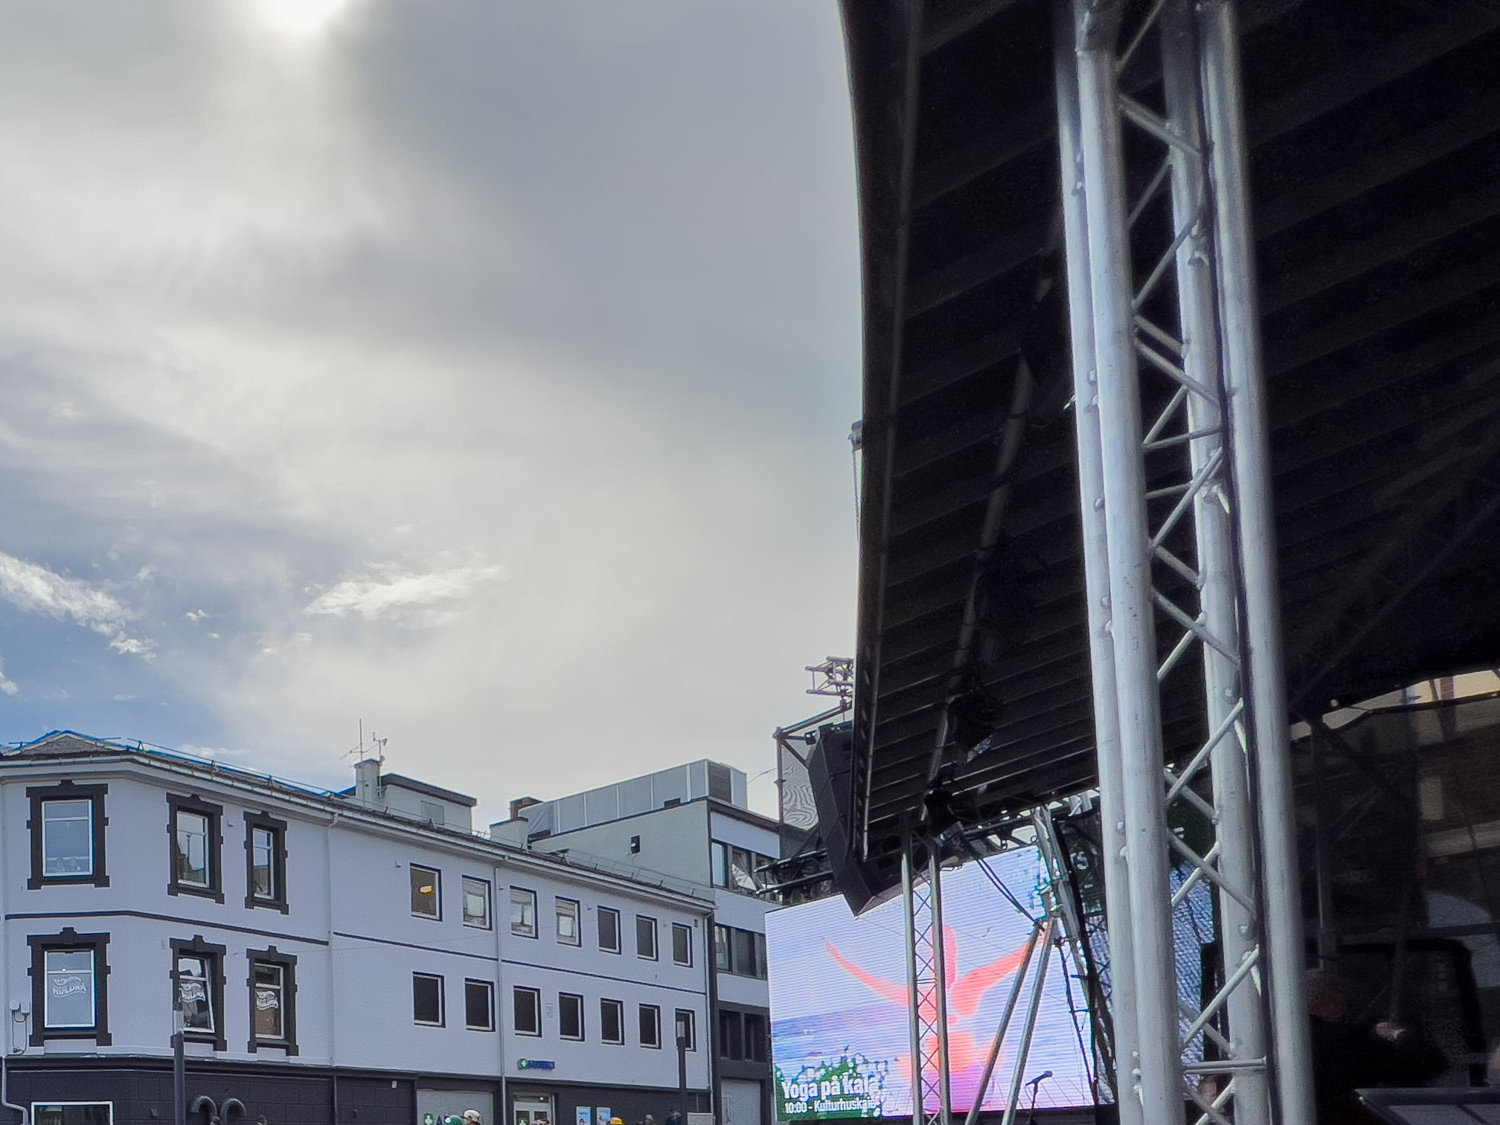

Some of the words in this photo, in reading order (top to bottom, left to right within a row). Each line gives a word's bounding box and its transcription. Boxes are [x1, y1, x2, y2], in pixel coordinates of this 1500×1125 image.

[781, 1080, 818, 1102] Yoga
[820, 1075, 841, 1100] på
[784, 1101, 808, 1114] 10:00
